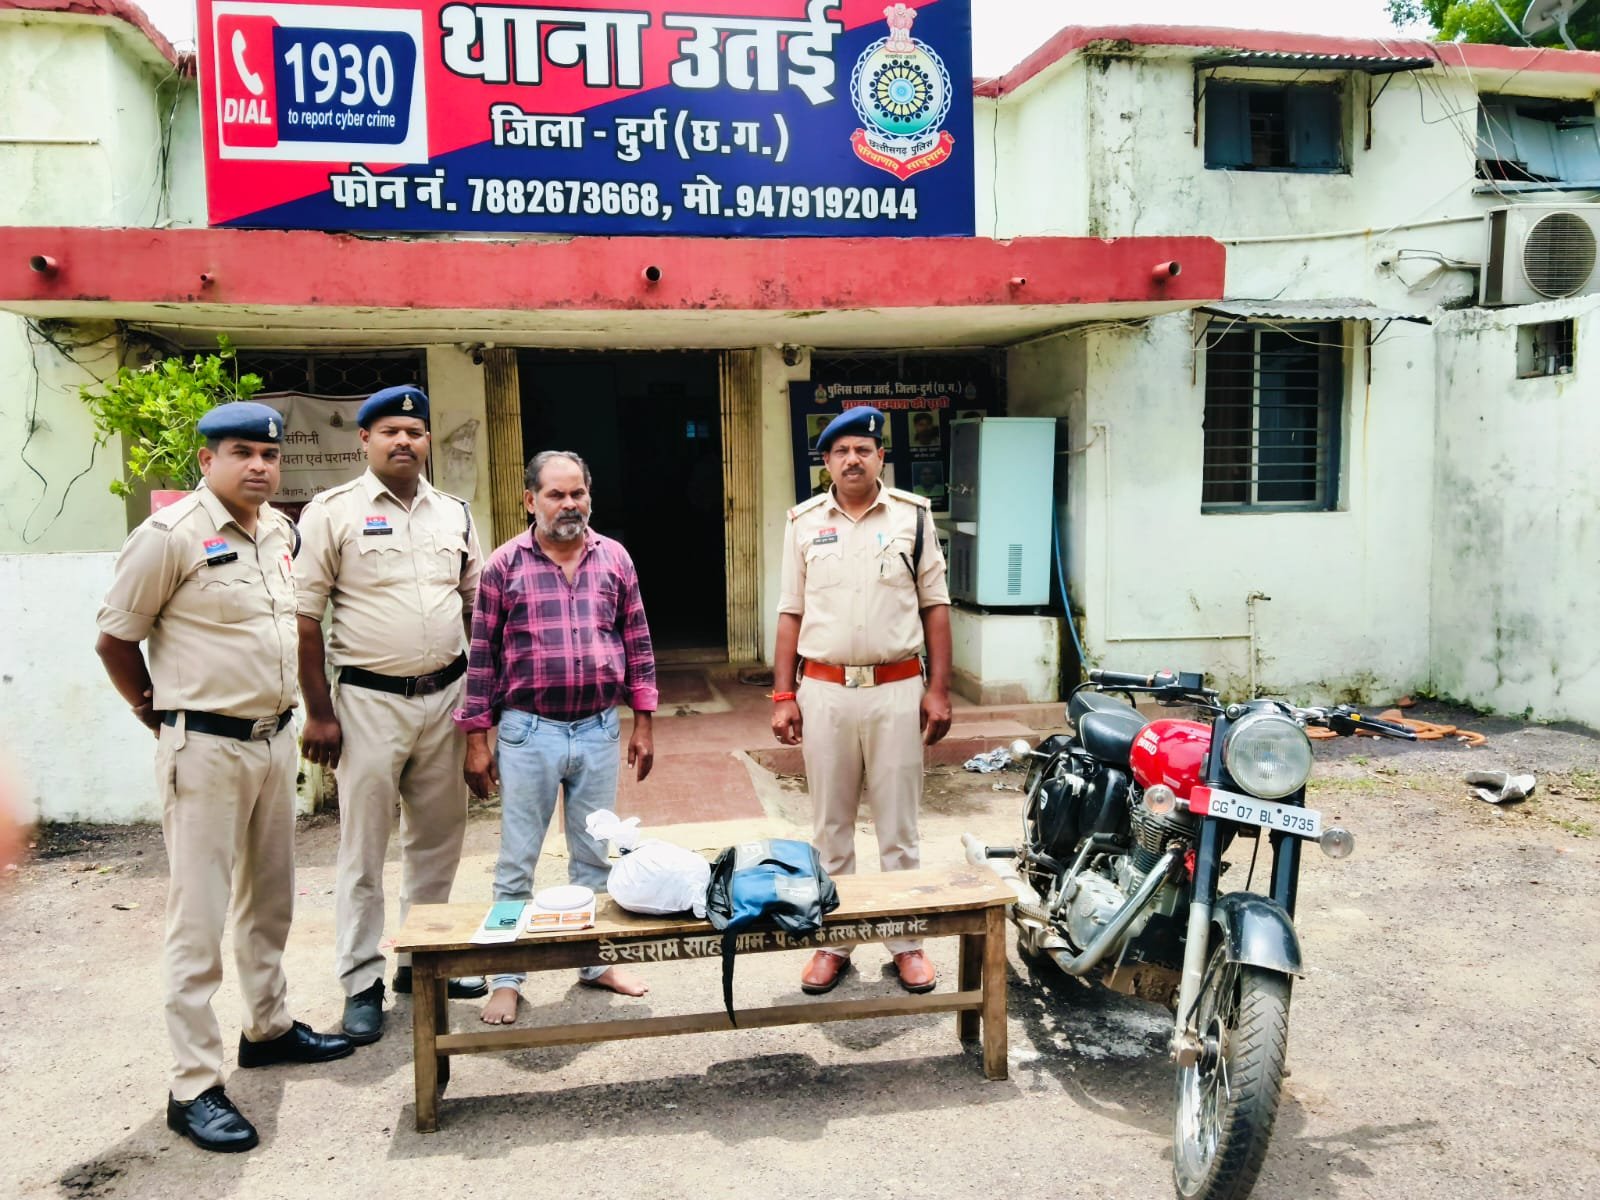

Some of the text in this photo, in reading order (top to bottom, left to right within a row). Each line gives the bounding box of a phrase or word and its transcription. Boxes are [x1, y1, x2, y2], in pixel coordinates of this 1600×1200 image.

[440, 0, 842, 105] थाना उतई
[284, 41, 394, 107] 1930
[223, 98, 272, 125] DIAL
[287, 108, 396, 131] to report cyber crime
[490, 104, 585, 148] जिला
[615, 108, 668, 162] दुर्ग
[330, 165, 409, 209] फोन
[414, 168, 457, 212] नं.
[467, 178, 672, 221] 7882673668,
[827, 383, 852, 399] पुलिस
[305, 450, 323, 467] एवं
[324, 448, 361, 464] परामर्श
[1211, 799, 1315, 832] CG 07 BL 9735
[829, 925, 857, 942] तरफ
[858, 918, 873, 941] से
